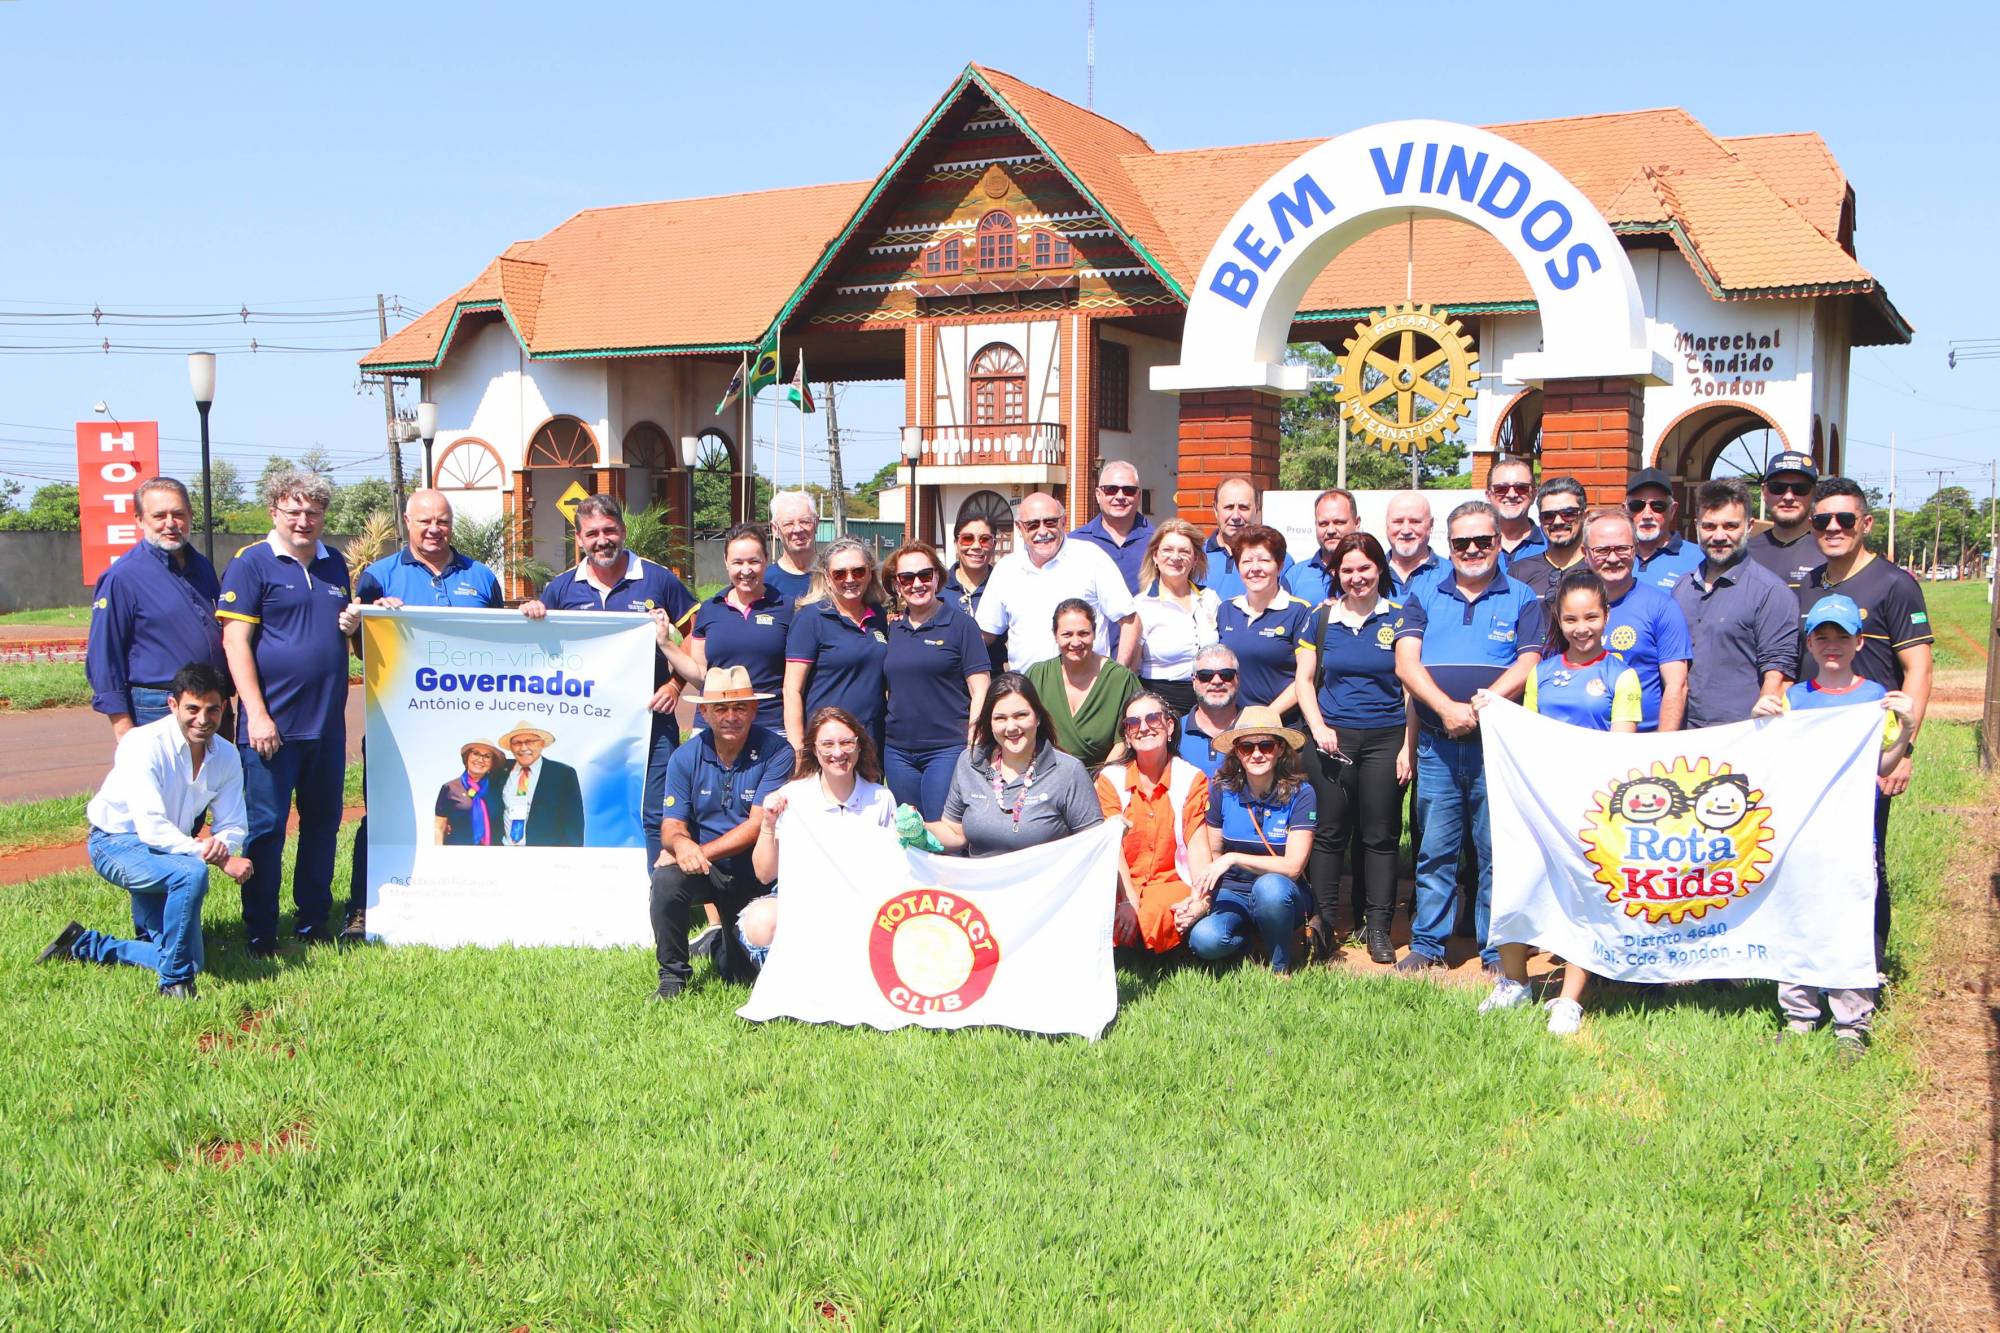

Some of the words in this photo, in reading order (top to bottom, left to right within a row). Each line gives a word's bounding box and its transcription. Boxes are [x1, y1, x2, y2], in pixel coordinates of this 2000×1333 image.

[1208, 173, 1336, 309] BEM
[1369, 142, 1602, 291] VINDOS
[1374, 315, 1441, 335] ROTARY
[1674, 328, 1781, 352] Marechal
[1684, 352, 1774, 374] Cândido
[1690, 376, 1765, 396] Rondon
[1350, 397, 1460, 440] INTERNATIONAL
[1286, 525, 1313, 534] Prova
[428, 640, 583, 671] Bem-vindo
[415, 667, 595, 698] Governador
[408, 697, 471, 711] Antônio
[475, 700, 485, 711] e
[488, 699, 554, 716] Juceney
[559, 702, 579, 715] Da
[583, 704, 612, 718] Caz
[1624, 826, 1736, 862] Rota
[1622, 866, 1735, 900] Kids
[1624, 932, 1681, 948] Distrito
[1687, 922, 1727, 940] 4640
[1592, 941, 1620, 965] Mal.
[1669, 943, 1730, 961] Rondon
[1748, 943, 1768, 960] PR
[889, 986, 963, 1013] CLUB
